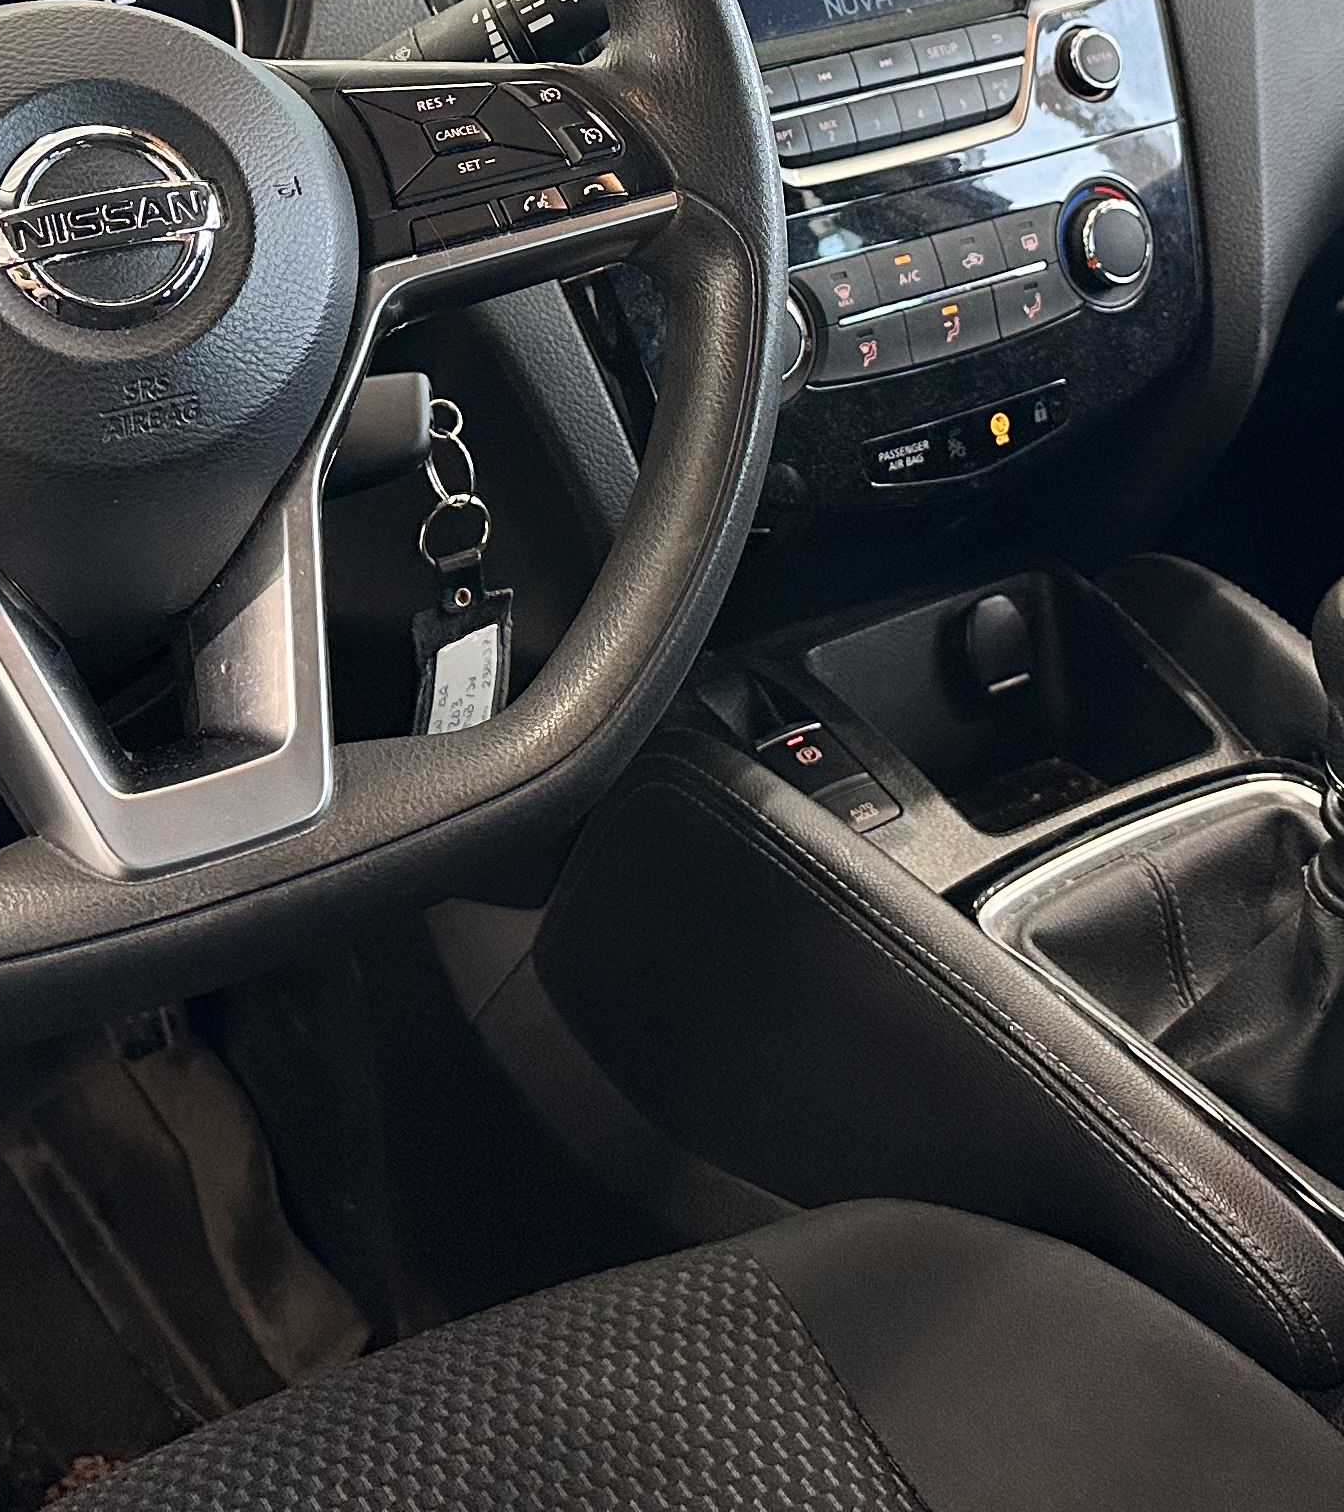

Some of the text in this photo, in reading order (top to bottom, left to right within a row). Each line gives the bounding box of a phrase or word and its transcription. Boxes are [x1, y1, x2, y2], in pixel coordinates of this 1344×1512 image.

[416, 96, 443, 112] RES
[435, 124, 481, 142] CANCEL
[457, 158, 481, 174] SET
[12, 190, 206, 253] NISSAN
[899, 269, 921, 285] A/C
[878, 439, 930, 463] PASSENGER
[888, 458, 905, 472] AIR
